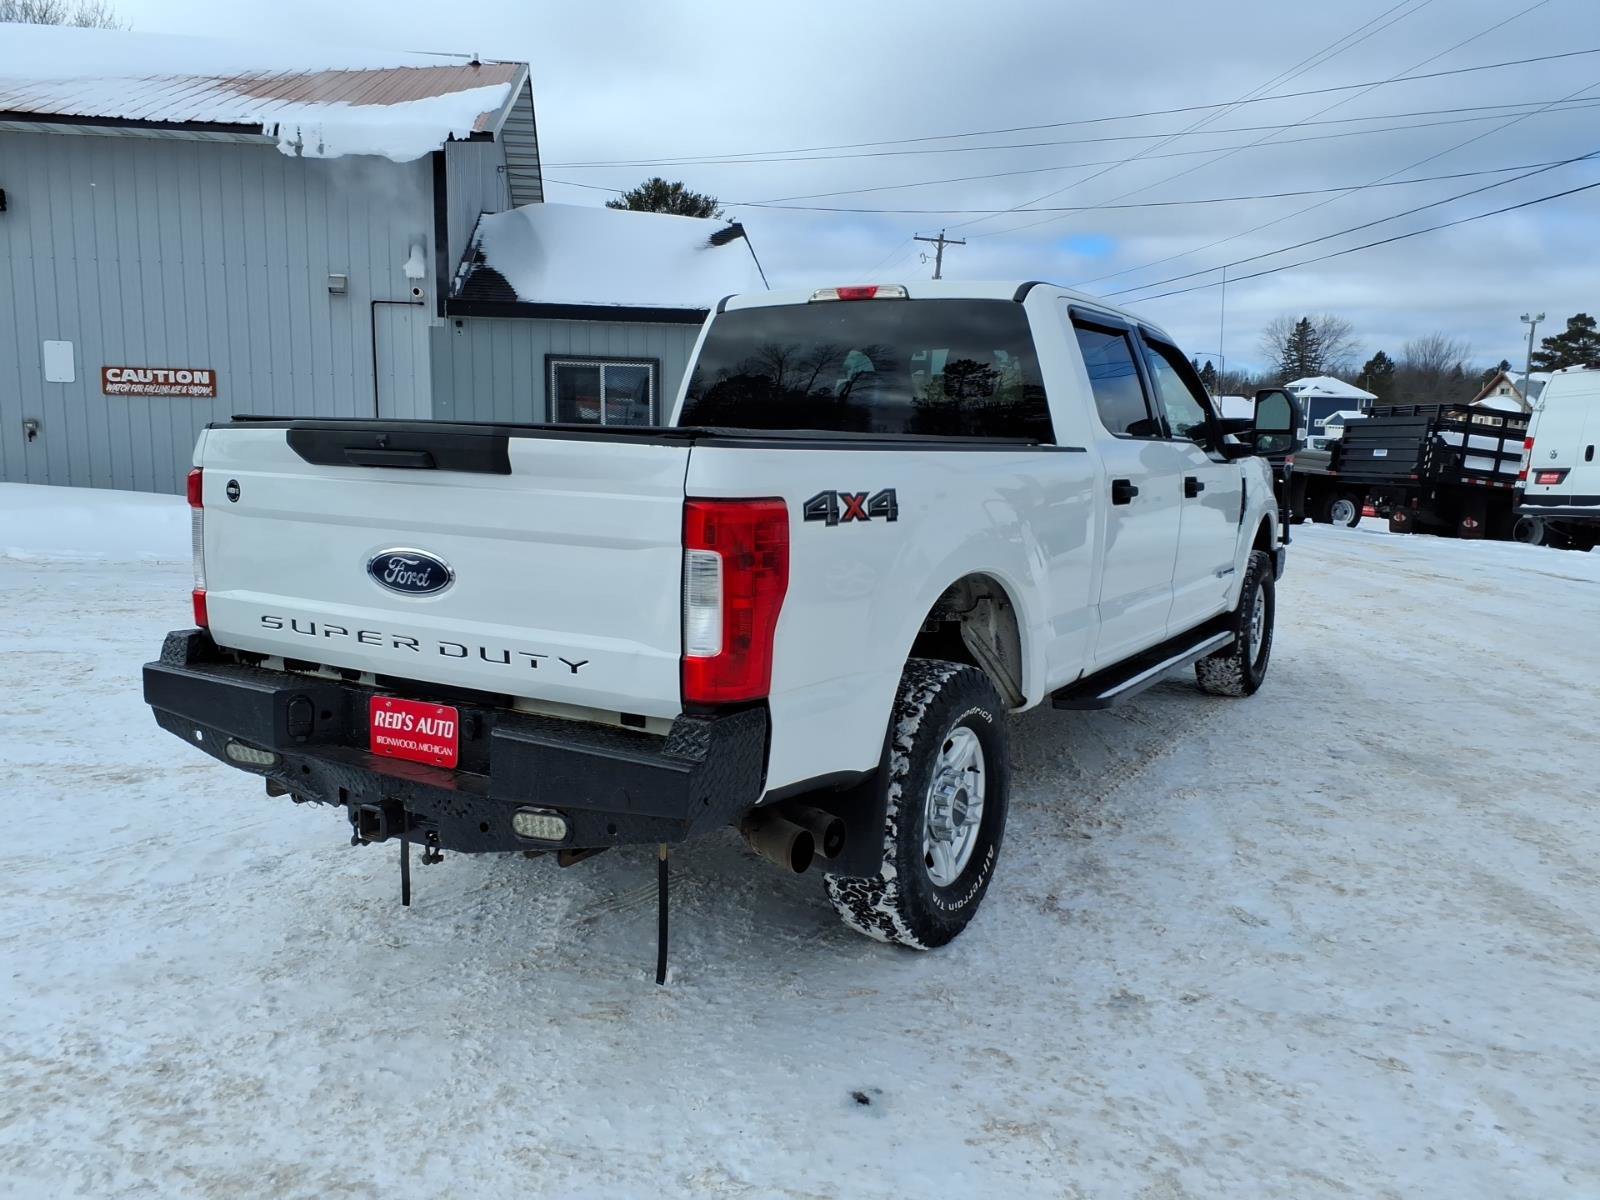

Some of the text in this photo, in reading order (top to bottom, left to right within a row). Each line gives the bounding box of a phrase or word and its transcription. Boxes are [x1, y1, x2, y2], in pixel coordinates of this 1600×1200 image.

[106, 368, 209, 384] CAUTION
[106, 382, 131, 392] WATCH
[131, 384, 144, 393] FOR
[384, 556, 431, 587] Ford
[261, 614, 589, 674] SUPER DUTY
[374, 710, 454, 738] RED'S AUTO
[376, 735, 453, 756] IRONWOOD, MICHIGAN
